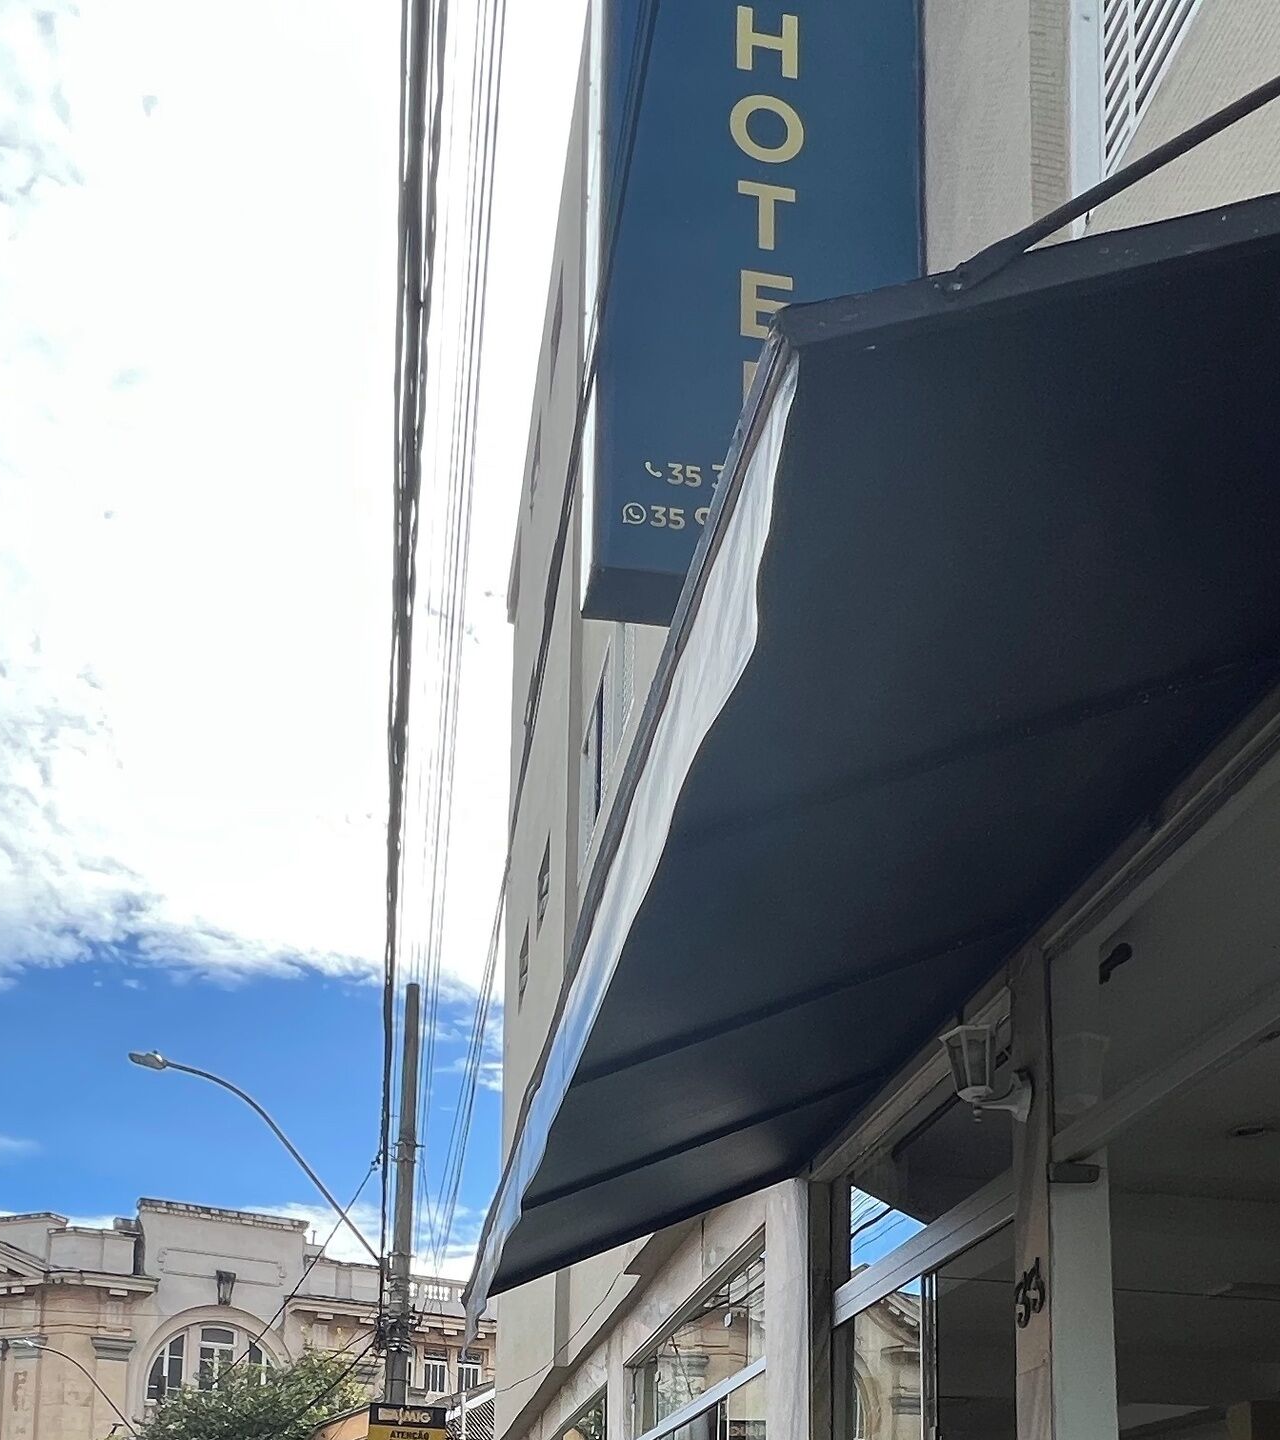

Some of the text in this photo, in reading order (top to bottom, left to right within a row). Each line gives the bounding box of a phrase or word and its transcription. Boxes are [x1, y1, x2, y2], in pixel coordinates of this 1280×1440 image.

[729, 5, 805, 402] HOTE
[666, 462, 702, 488] 35
[649, 505, 686, 530] 35
[378, 1406, 431, 1425] MIG
[389, 1430, 430, 1440] ATENÇÃO
